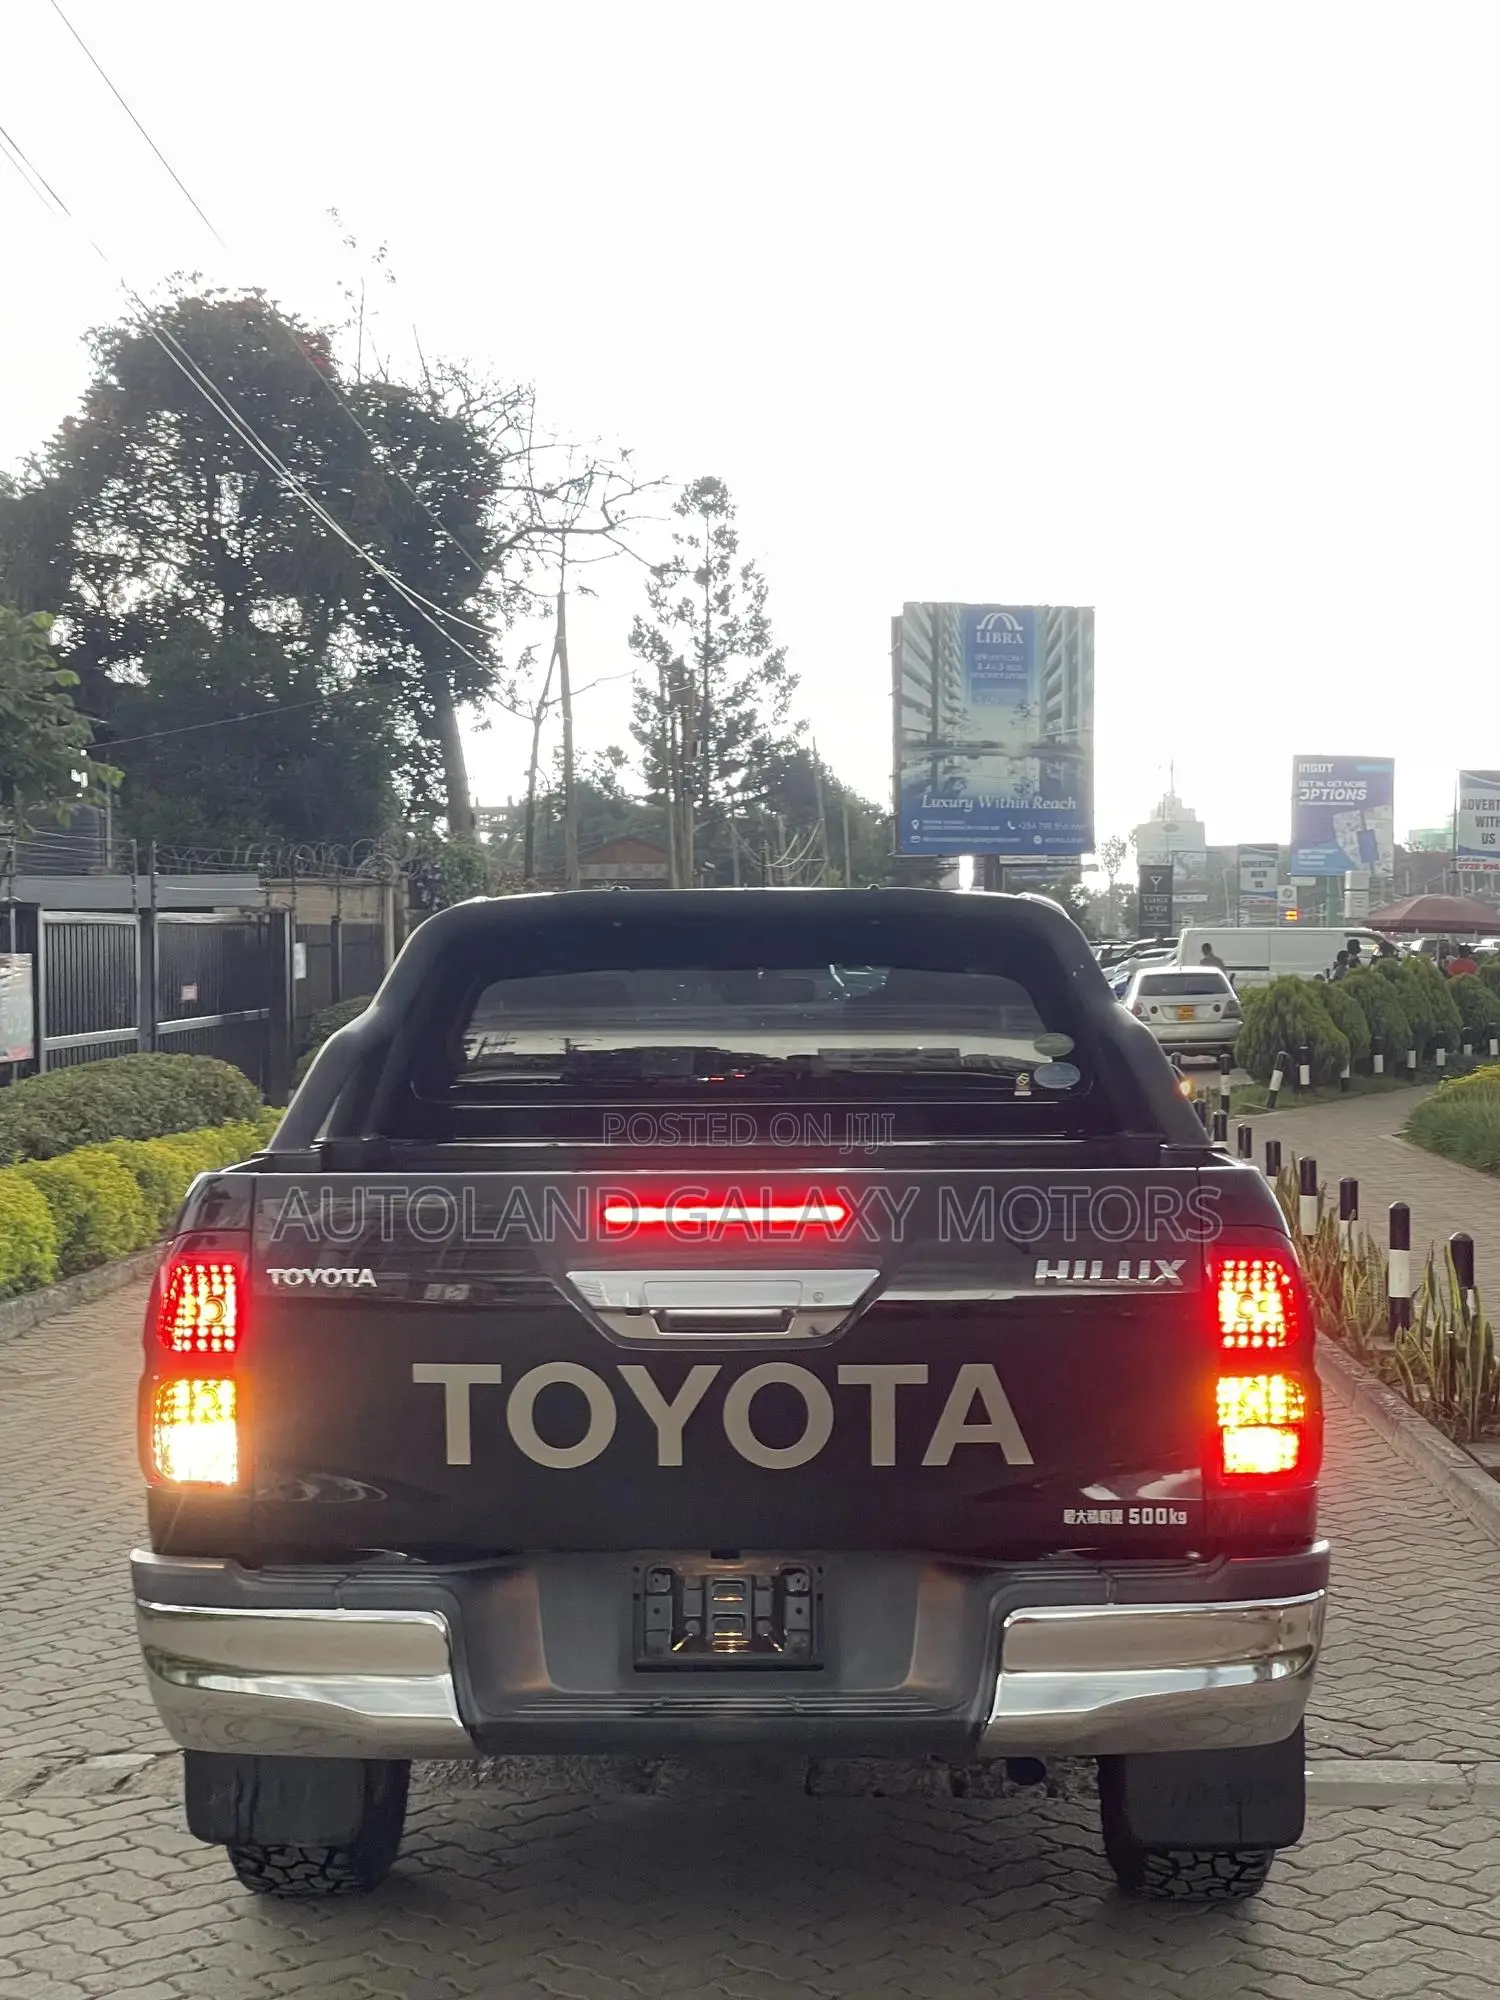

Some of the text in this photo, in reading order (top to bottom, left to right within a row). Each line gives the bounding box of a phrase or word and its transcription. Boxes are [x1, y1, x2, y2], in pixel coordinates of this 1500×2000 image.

[976, 631, 1024, 644] LIBRA
[1298, 763, 1334, 773] INGOT
[921, 794, 1077, 812] Luxury Within Reach
[1299, 788, 1368, 801] OPTIONS
[1481, 832, 1496, 845] US
[266, 1268, 378, 1288] TOYOTA
[1034, 1259, 1187, 1286] HILUX
[412, 1361, 1034, 1469] TOYOTA
[1128, 1507, 1187, 1525] 500kg
